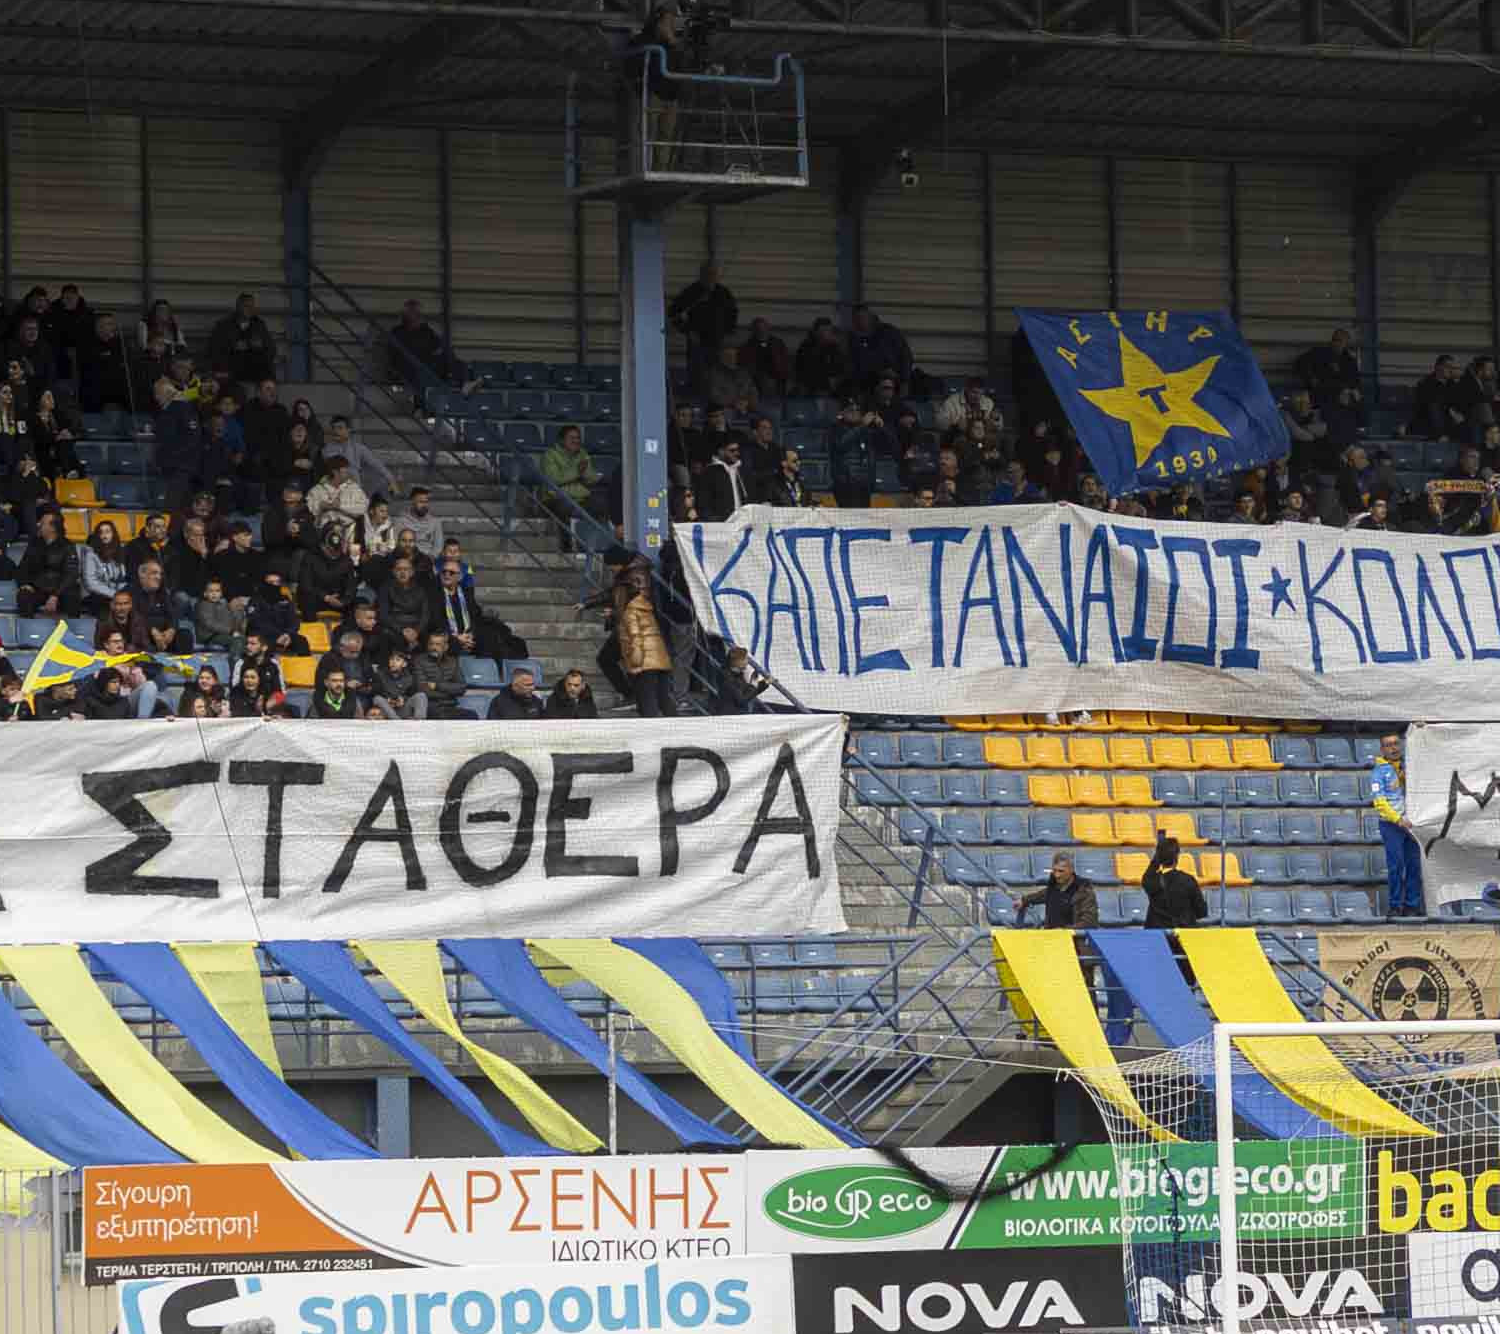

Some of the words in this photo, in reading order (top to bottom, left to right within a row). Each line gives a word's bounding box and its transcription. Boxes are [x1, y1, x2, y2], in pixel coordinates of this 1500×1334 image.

[692, 524, 1261, 677] ΚΑΠΕΤΑΝΑΙΟΙ
[81, 742, 822, 899] ΣΤΑΘΕΡΑ
[95, 1180, 191, 1209] Σίγουρη
[404, 1167, 731, 1234] ΑΡΣΕΝΗΣ
[787, 1188, 828, 1214] bio
[878, 1190, 933, 1213] eco
[1003, 1160, 1347, 1204] www.biogreco.gr
[96, 1210, 259, 1243] εξυπηρέτηση!
[1004, 1216, 1104, 1238] ΒΙΟΛΟΓΙΚΑ
[1109, 1214, 1220, 1235] ΚΟΤΟΠΟΥΛΑ
[1240, 1210, 1348, 1230] ΖΩΟΤΡΟΦΕΣ
[95, 1264, 141, 1278] ΤΕΡΜΑ
[211, 1261, 264, 1275] ΤΡΙΠΟΛΗ
[273, 1260, 300, 1273] ΤΗΛ.
[303, 1259, 332, 1272] 2710
[333, 1258, 373, 1271] 232451
[552, 1239, 657, 1263] ΙΔΙΩΤΙΚΟ
[666, 1237, 732, 1259] ΚΤΕΟ
[833, 1279, 1085, 1334] NOVA
[1139, 1268, 1385, 1323] NOVA
